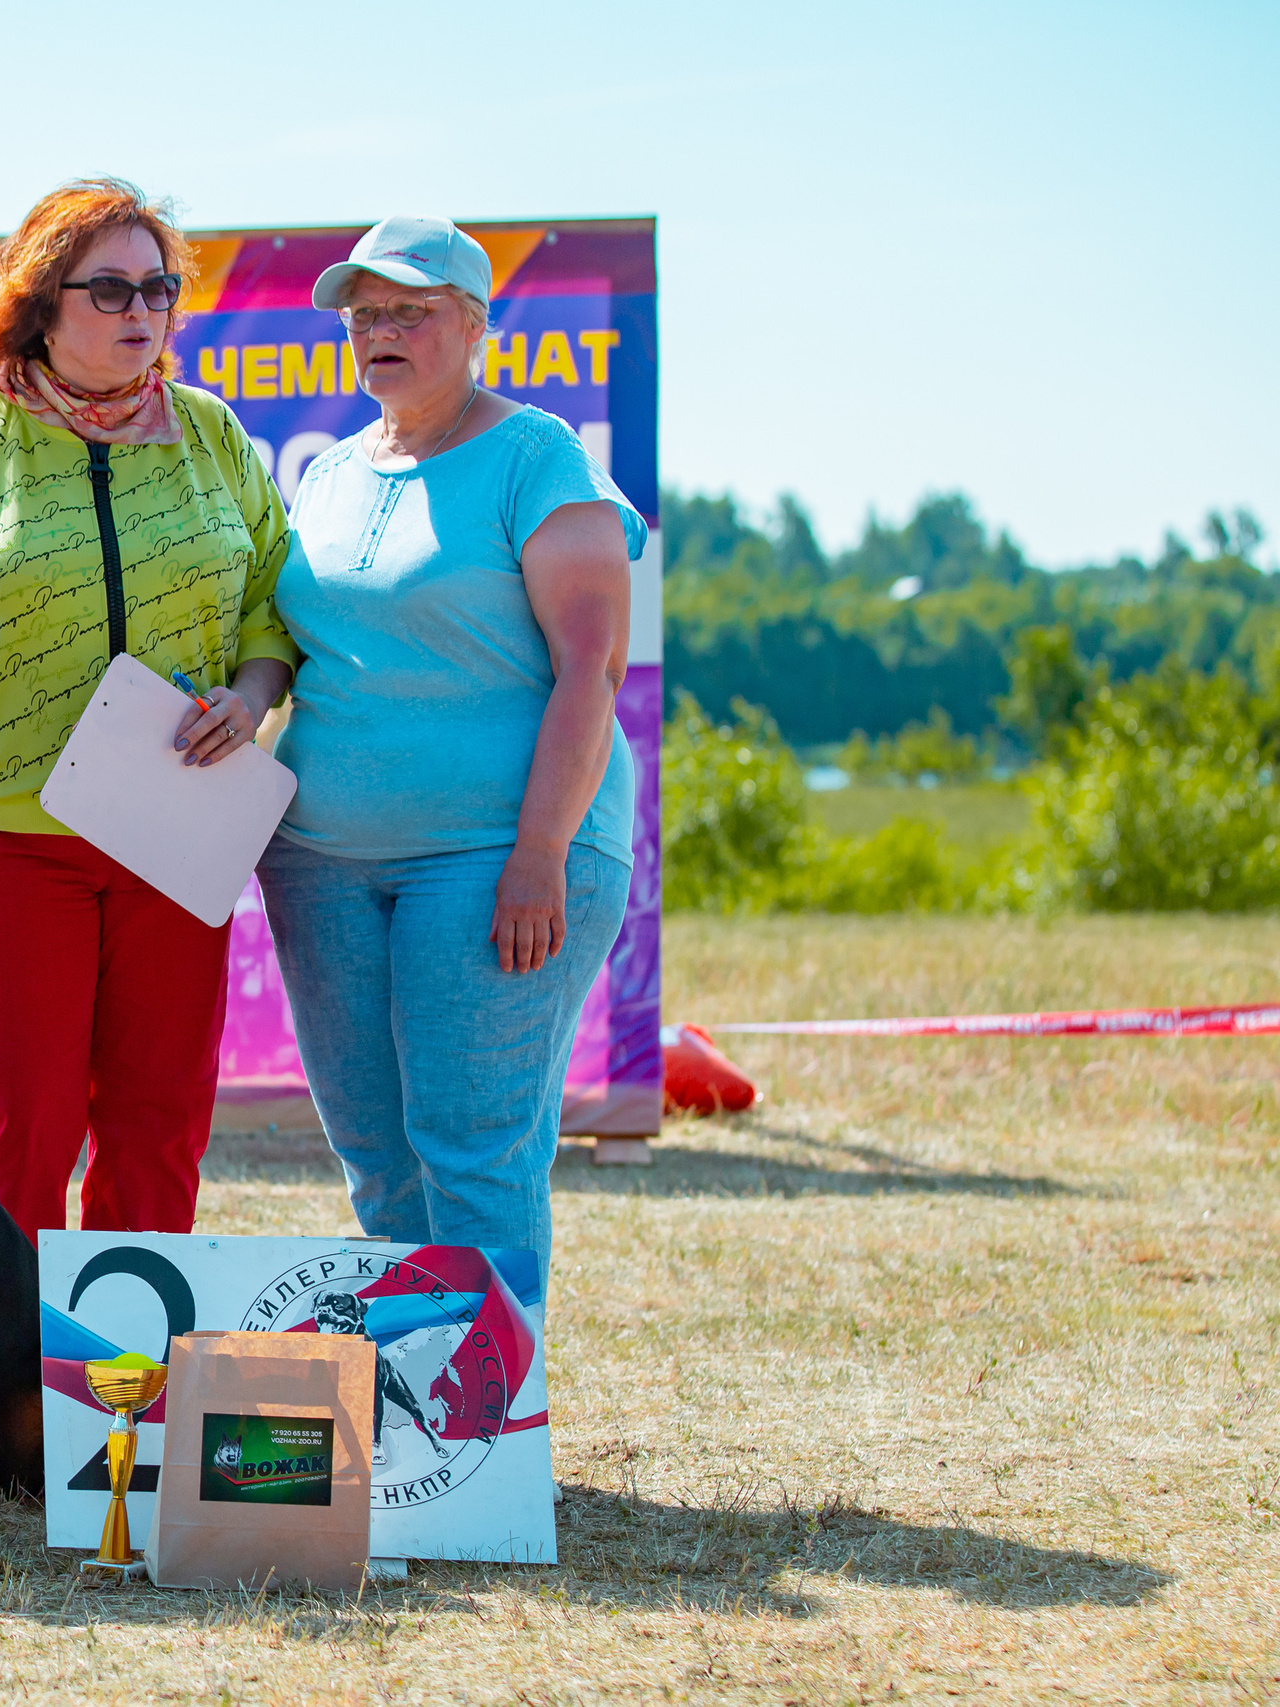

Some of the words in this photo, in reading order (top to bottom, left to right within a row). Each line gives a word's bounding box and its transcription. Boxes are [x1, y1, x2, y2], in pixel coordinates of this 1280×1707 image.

[67, 1246, 196, 1491] 2
[357, 1257, 449, 1301] КЛУБ
[456, 1309, 503, 1445] РОССИИ
[242, 1455, 326, 1479] ВОЖАК
[271, 1437, 322, 1446] VOZHAK-ZOO.RU
